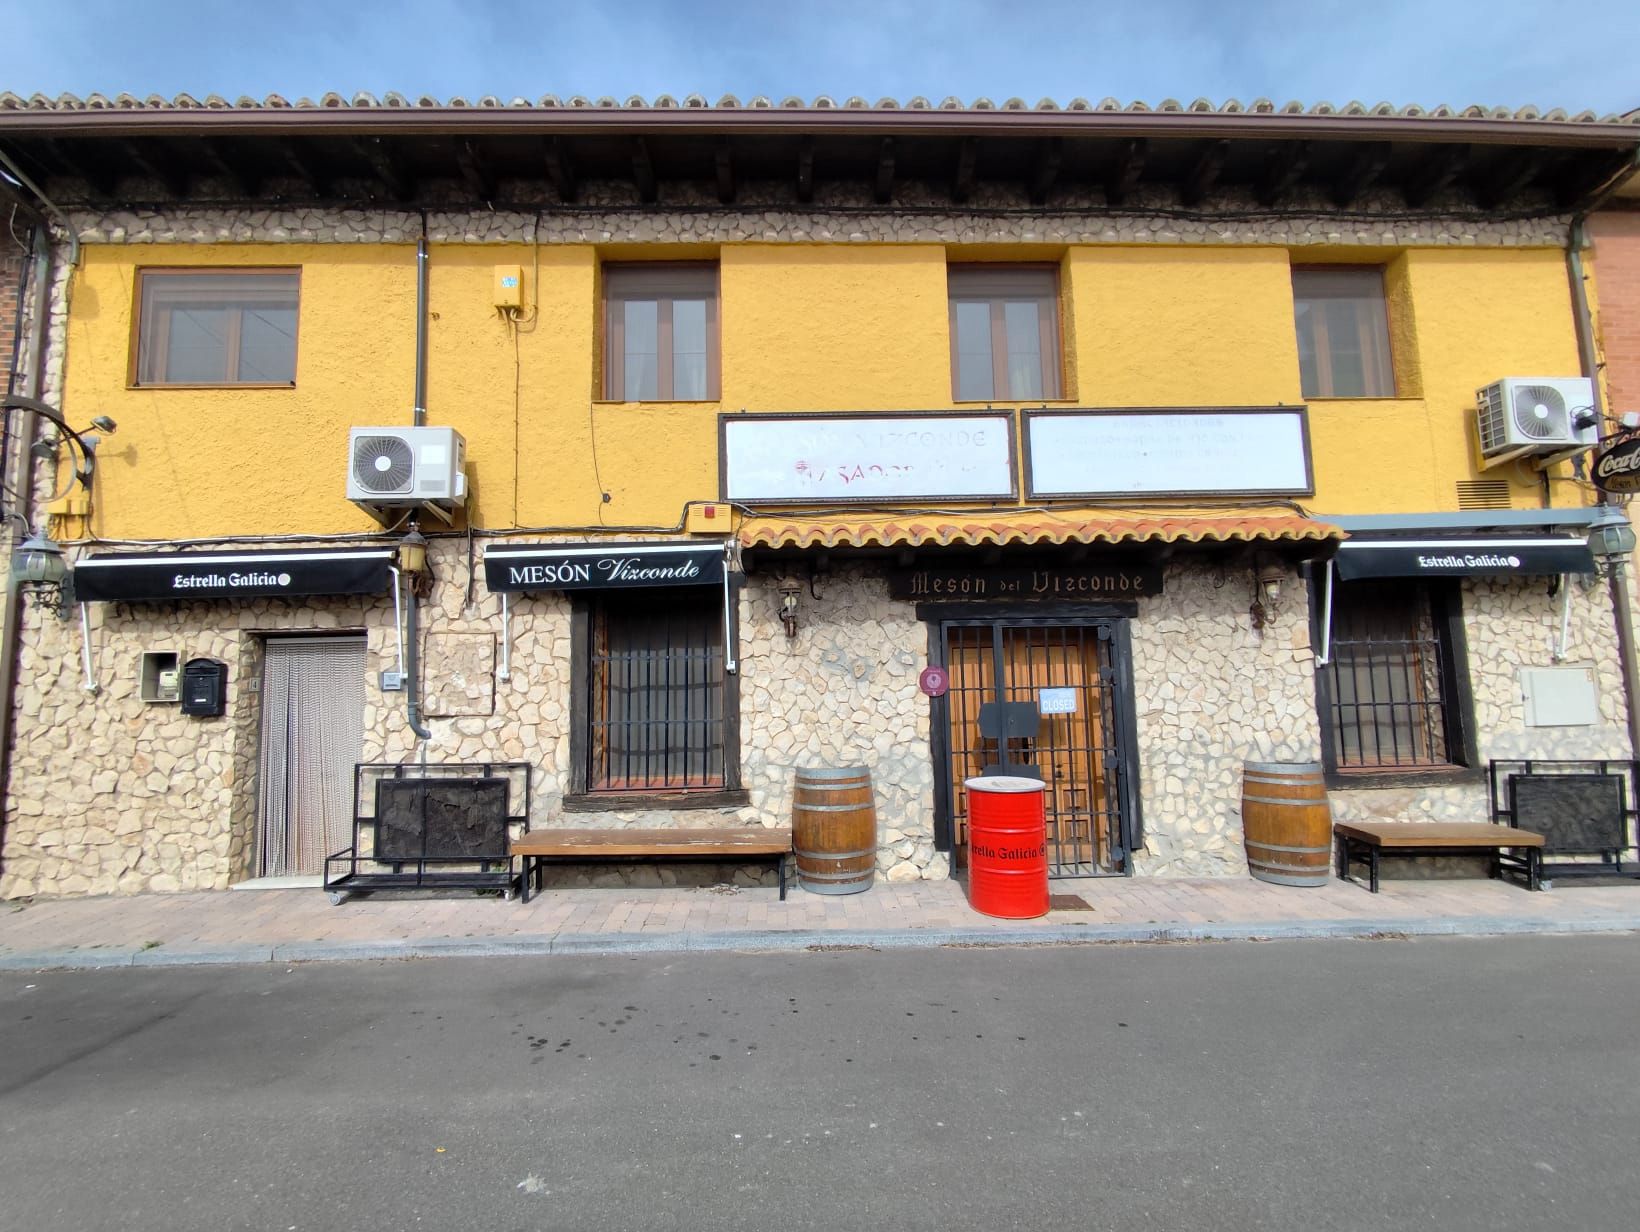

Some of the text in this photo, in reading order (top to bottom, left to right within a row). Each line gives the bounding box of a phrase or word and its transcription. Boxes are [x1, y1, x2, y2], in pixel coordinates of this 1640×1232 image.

[1418, 554, 1509, 567] Estrella Galicia
[509, 558, 700, 584] MESÓN Vizconde
[173, 572, 277, 588] Estrella Galicia
[1000, 579, 1020, 592] del
[1032, 571, 1144, 593] Vizconde
[1042, 699, 1076, 711] CLOSED
[998, 847, 1037, 860] Galicia
